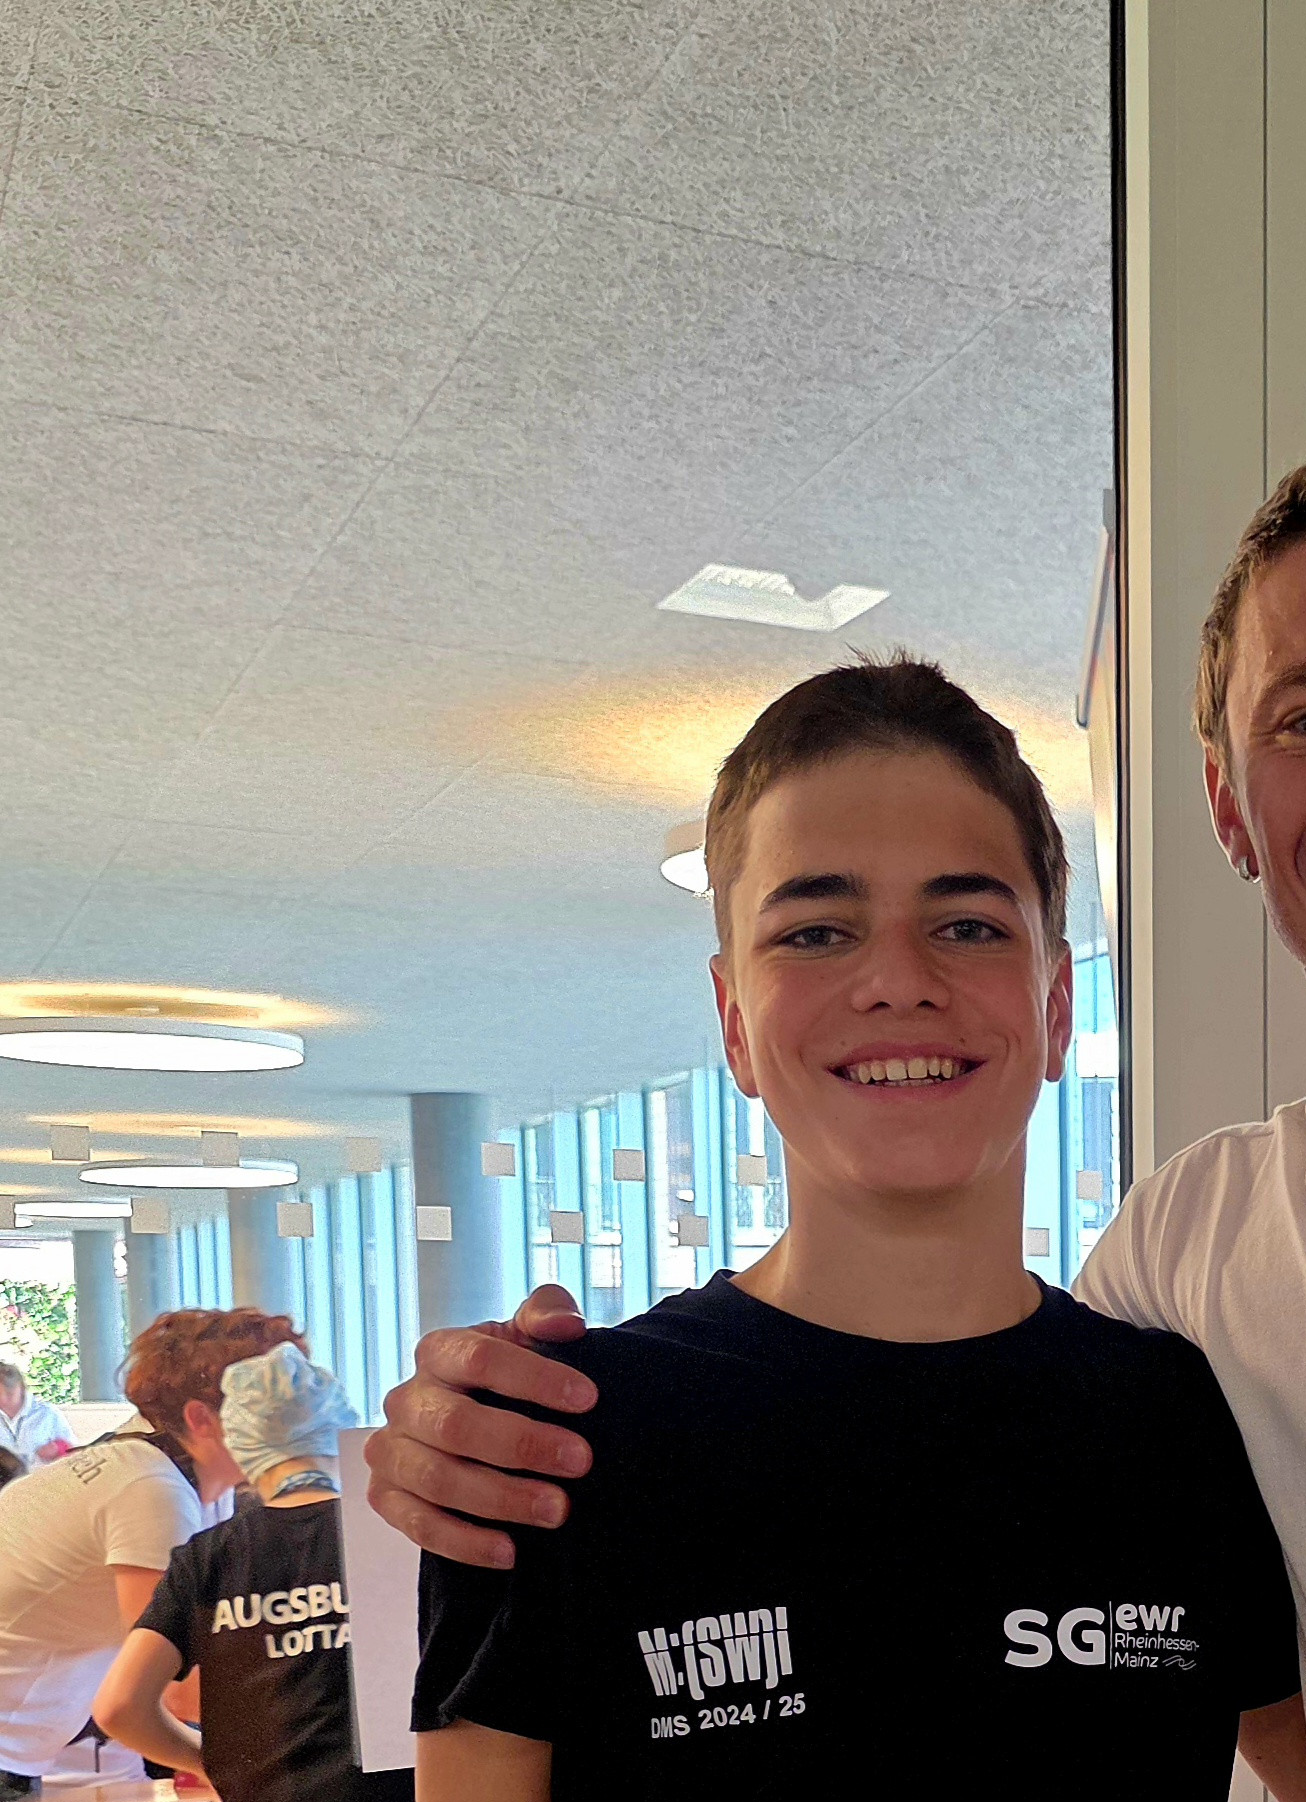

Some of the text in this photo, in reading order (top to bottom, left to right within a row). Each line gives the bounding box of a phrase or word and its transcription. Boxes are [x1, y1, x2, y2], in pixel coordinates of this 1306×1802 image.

[1115, 1602, 1186, 1633] ewr
[1003, 1607, 1106, 1668] SG
[1114, 1651, 1159, 1668] Mainz
[650, 1692, 806, 1739] DMS 2024 / 25
